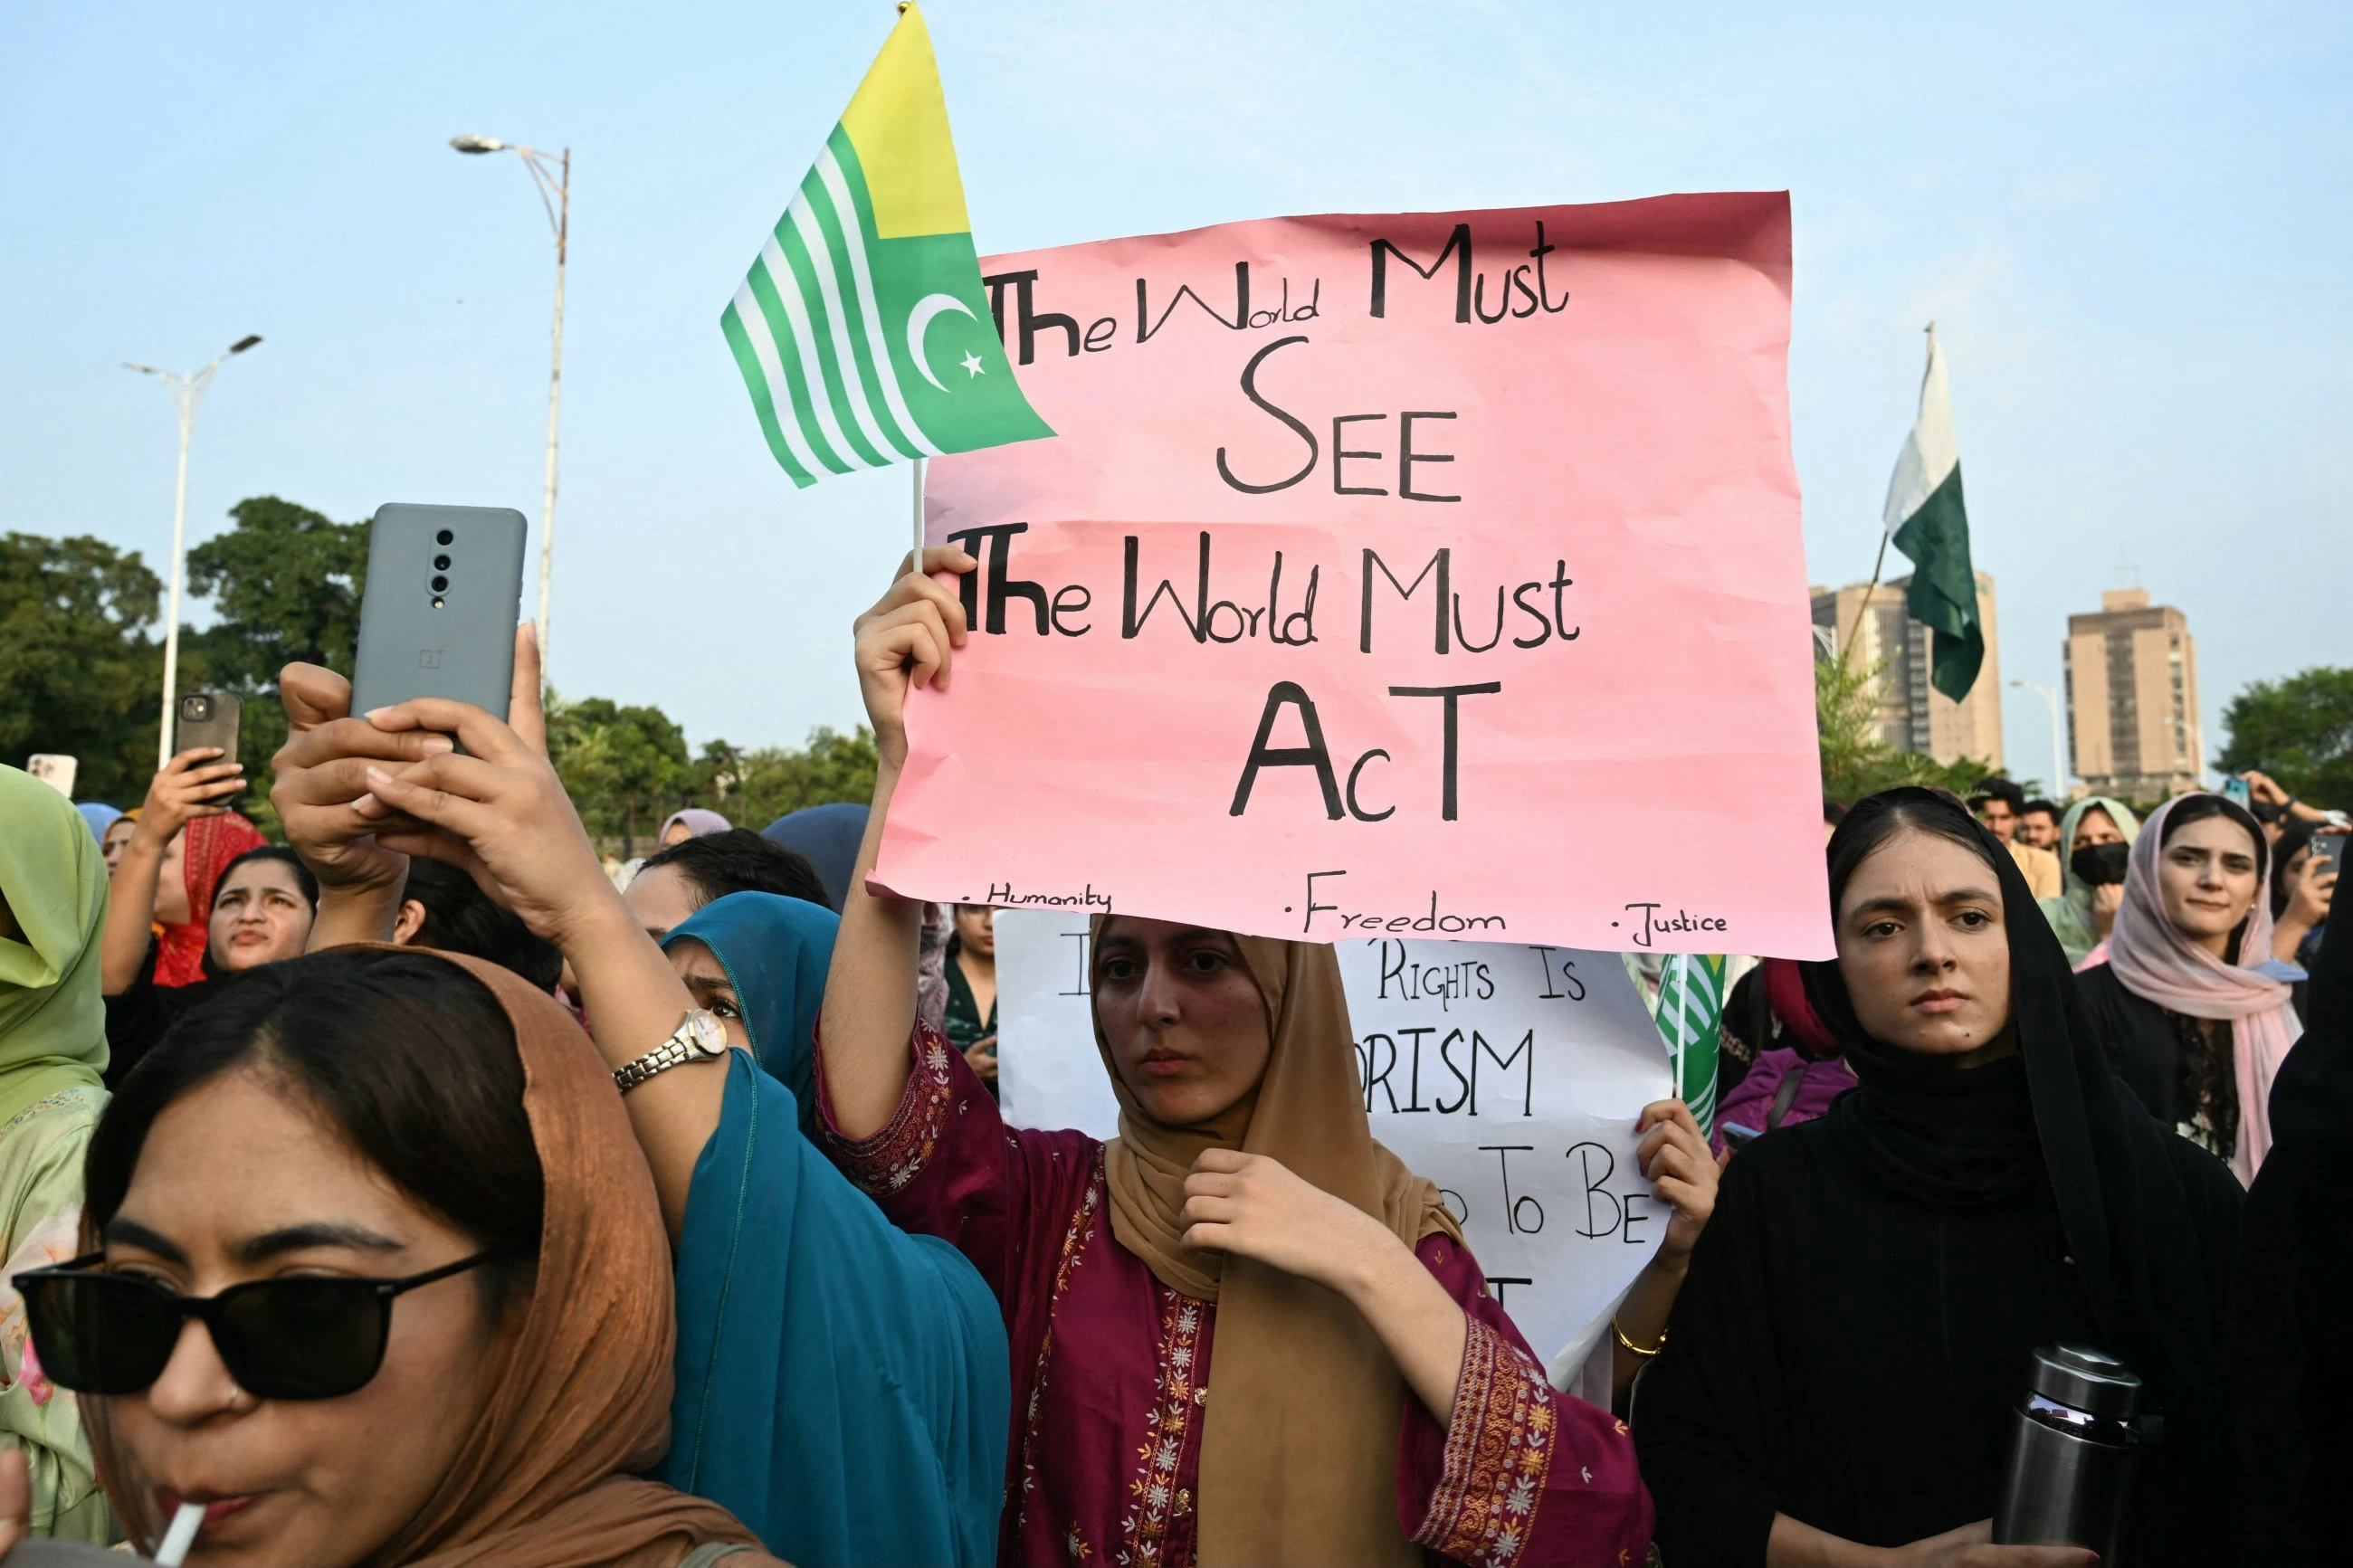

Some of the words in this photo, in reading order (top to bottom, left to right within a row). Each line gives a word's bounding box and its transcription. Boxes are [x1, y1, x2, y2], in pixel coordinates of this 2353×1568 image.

[983, 270, 1117, 366] The
[1136, 261, 1319, 343] World
[1371, 221, 1568, 323] Must
[1216, 337, 1462, 502] SEE
[948, 522, 1091, 637] The
[1122, 531, 1319, 645] World
[1360, 548, 1579, 654] Must
[986, 882, 1111, 914] Humanity
[1303, 870, 1506, 933] Freedom
[1625, 903, 1727, 946] Justice
